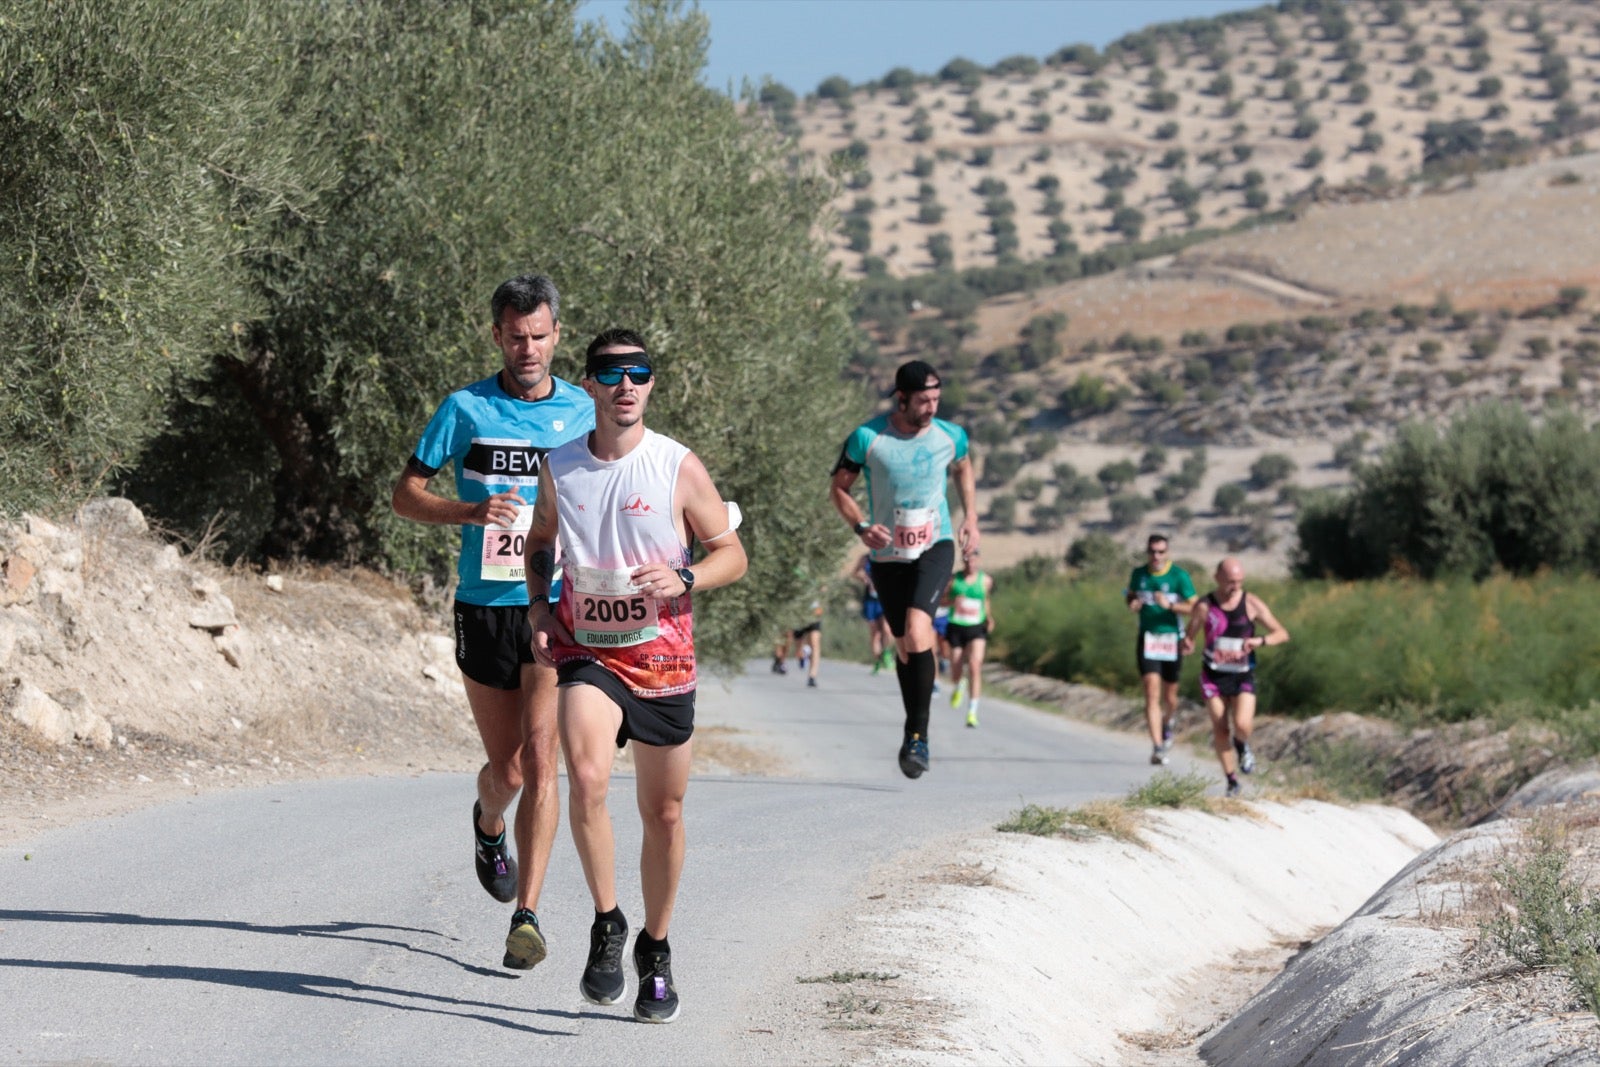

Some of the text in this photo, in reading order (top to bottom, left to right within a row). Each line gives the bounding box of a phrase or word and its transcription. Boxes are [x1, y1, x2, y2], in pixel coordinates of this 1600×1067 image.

[584, 597, 647, 623] 2005
[587, 630, 644, 645] EDUARDO JORGE
